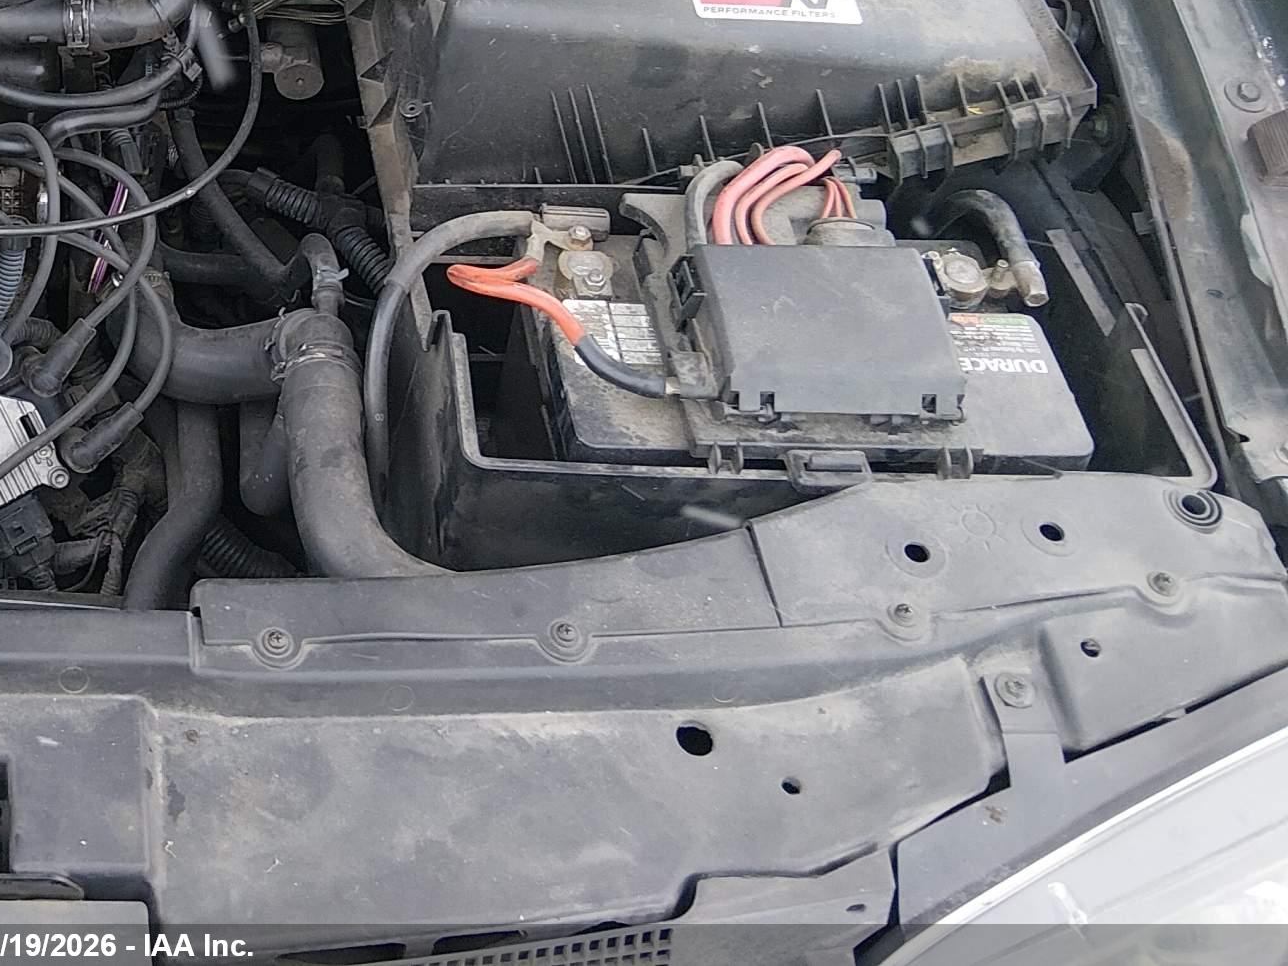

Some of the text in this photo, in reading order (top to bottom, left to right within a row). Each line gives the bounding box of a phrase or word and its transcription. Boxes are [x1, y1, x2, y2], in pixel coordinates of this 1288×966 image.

[703, 6, 836, 18] PERFORMANCE FILTERS
[958, 357, 1049, 374] DURACE
